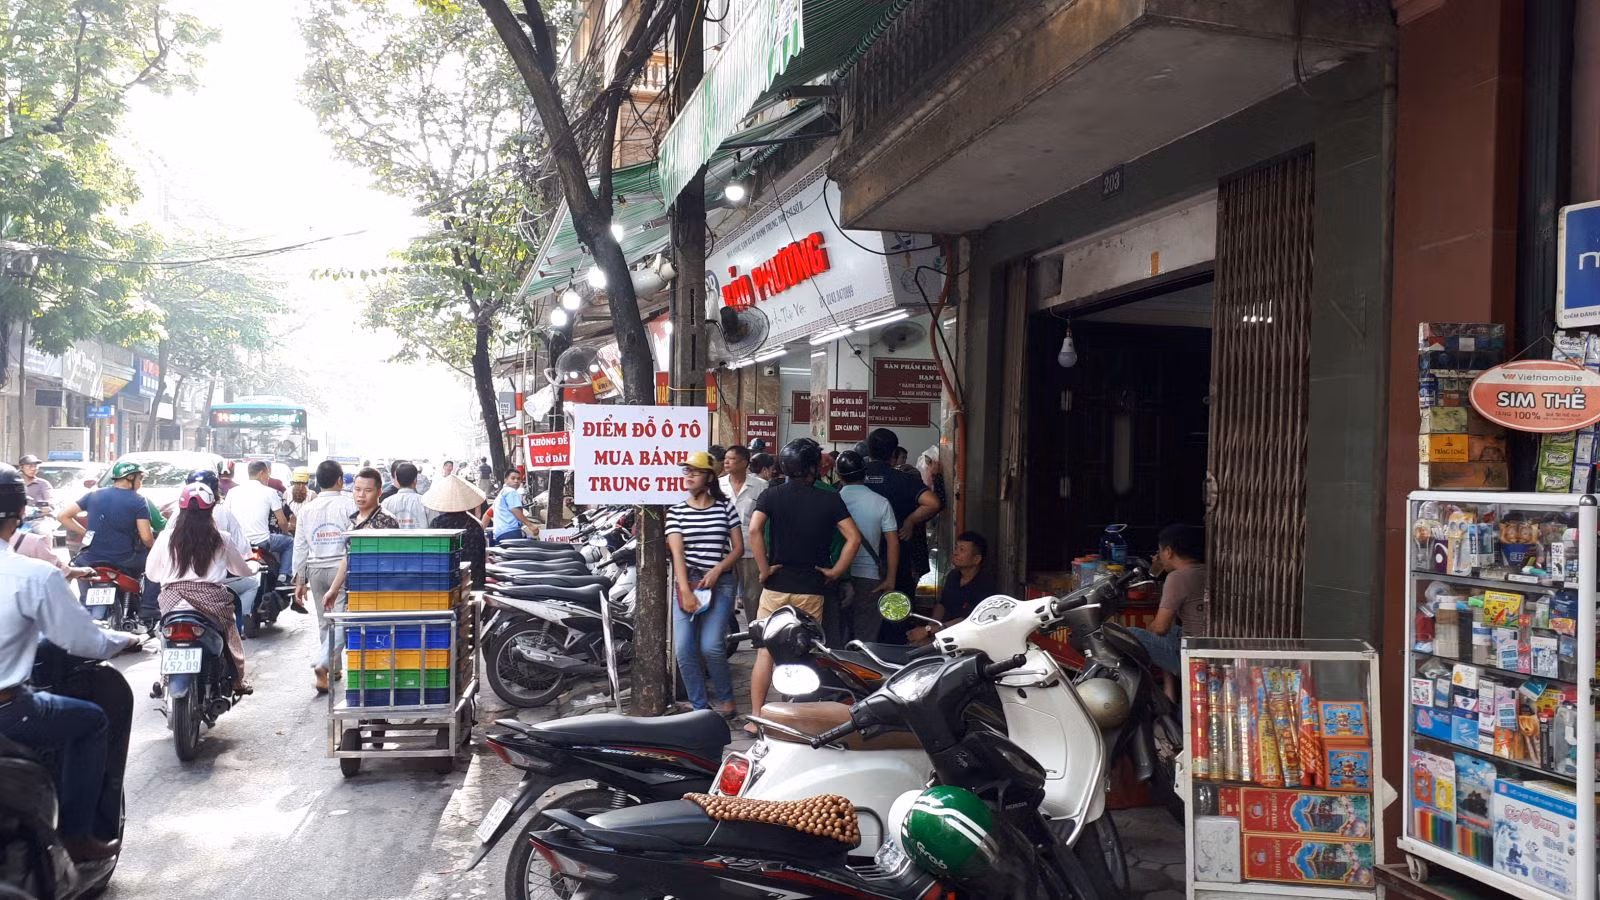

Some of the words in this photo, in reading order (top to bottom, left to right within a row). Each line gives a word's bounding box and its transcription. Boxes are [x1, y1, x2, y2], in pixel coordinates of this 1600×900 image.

[1104, 171, 1120, 194] 203
[1518, 373, 1583, 382] Vietnamobile
[1497, 390, 1536, 408] SIM
[1542, 387, 1586, 410] THẺ
[841, 408, 850, 417] ĐỔI
[1514, 411, 1541, 420] 100%
[583, 414, 627, 437] ĐIỂM
[632, 416, 656, 438] ĐỖ
[661, 419, 673, 438] Ô
[678, 419, 701, 438] TÔ
[530, 437, 556, 446] KHÔNG
[558, 433, 568, 445] ĐỂ
[535, 455, 544, 464] XE
[546, 452, 552, 463] Ở
[594, 450, 636, 466] MUA
[640, 446, 688, 466] BÁNH
[588, 477, 650, 492] TRUNG
[656, 477, 688, 492] THU
[168, 650, 196, 660] 29-B1
[164, 661, 198, 672] 452.09
[916, 841, 948, 870] Grab
